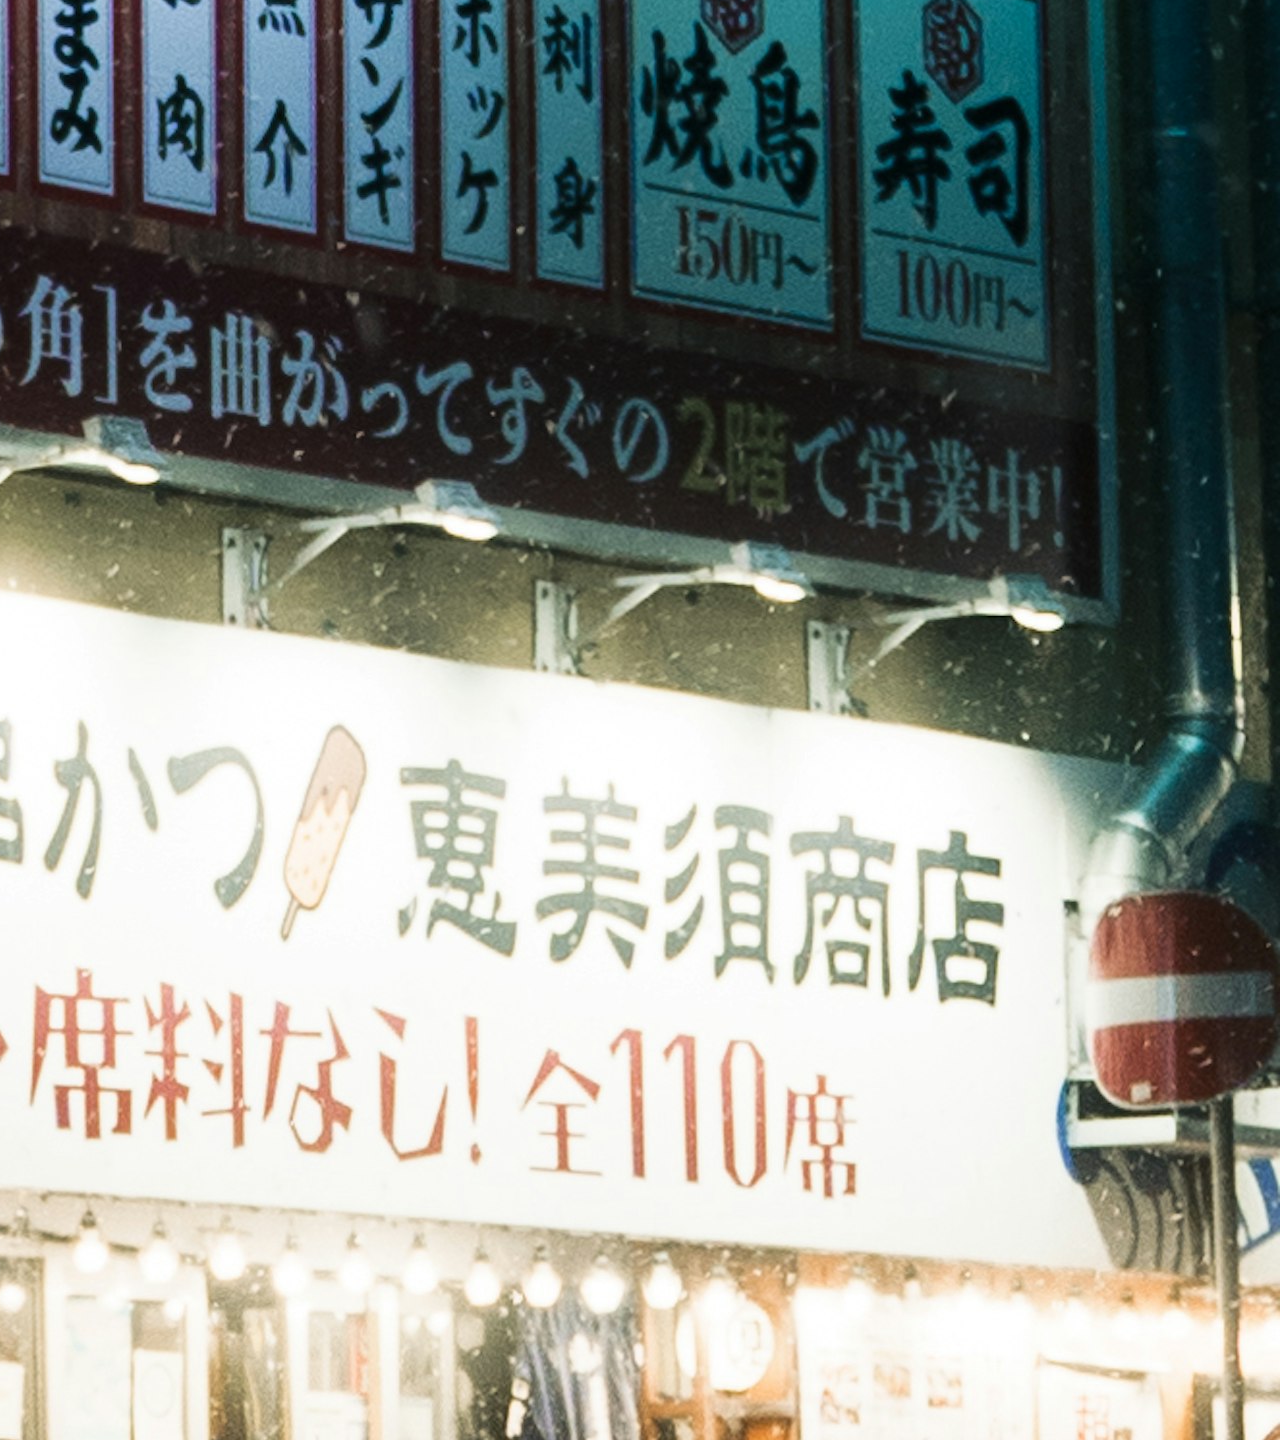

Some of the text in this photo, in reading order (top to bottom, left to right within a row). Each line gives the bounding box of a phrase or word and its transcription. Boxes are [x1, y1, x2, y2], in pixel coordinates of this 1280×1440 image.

[542, 3, 597, 252] 刺身
[640, 21, 821, 208] 焼鳥
[872, 68, 1032, 249] 寿司
